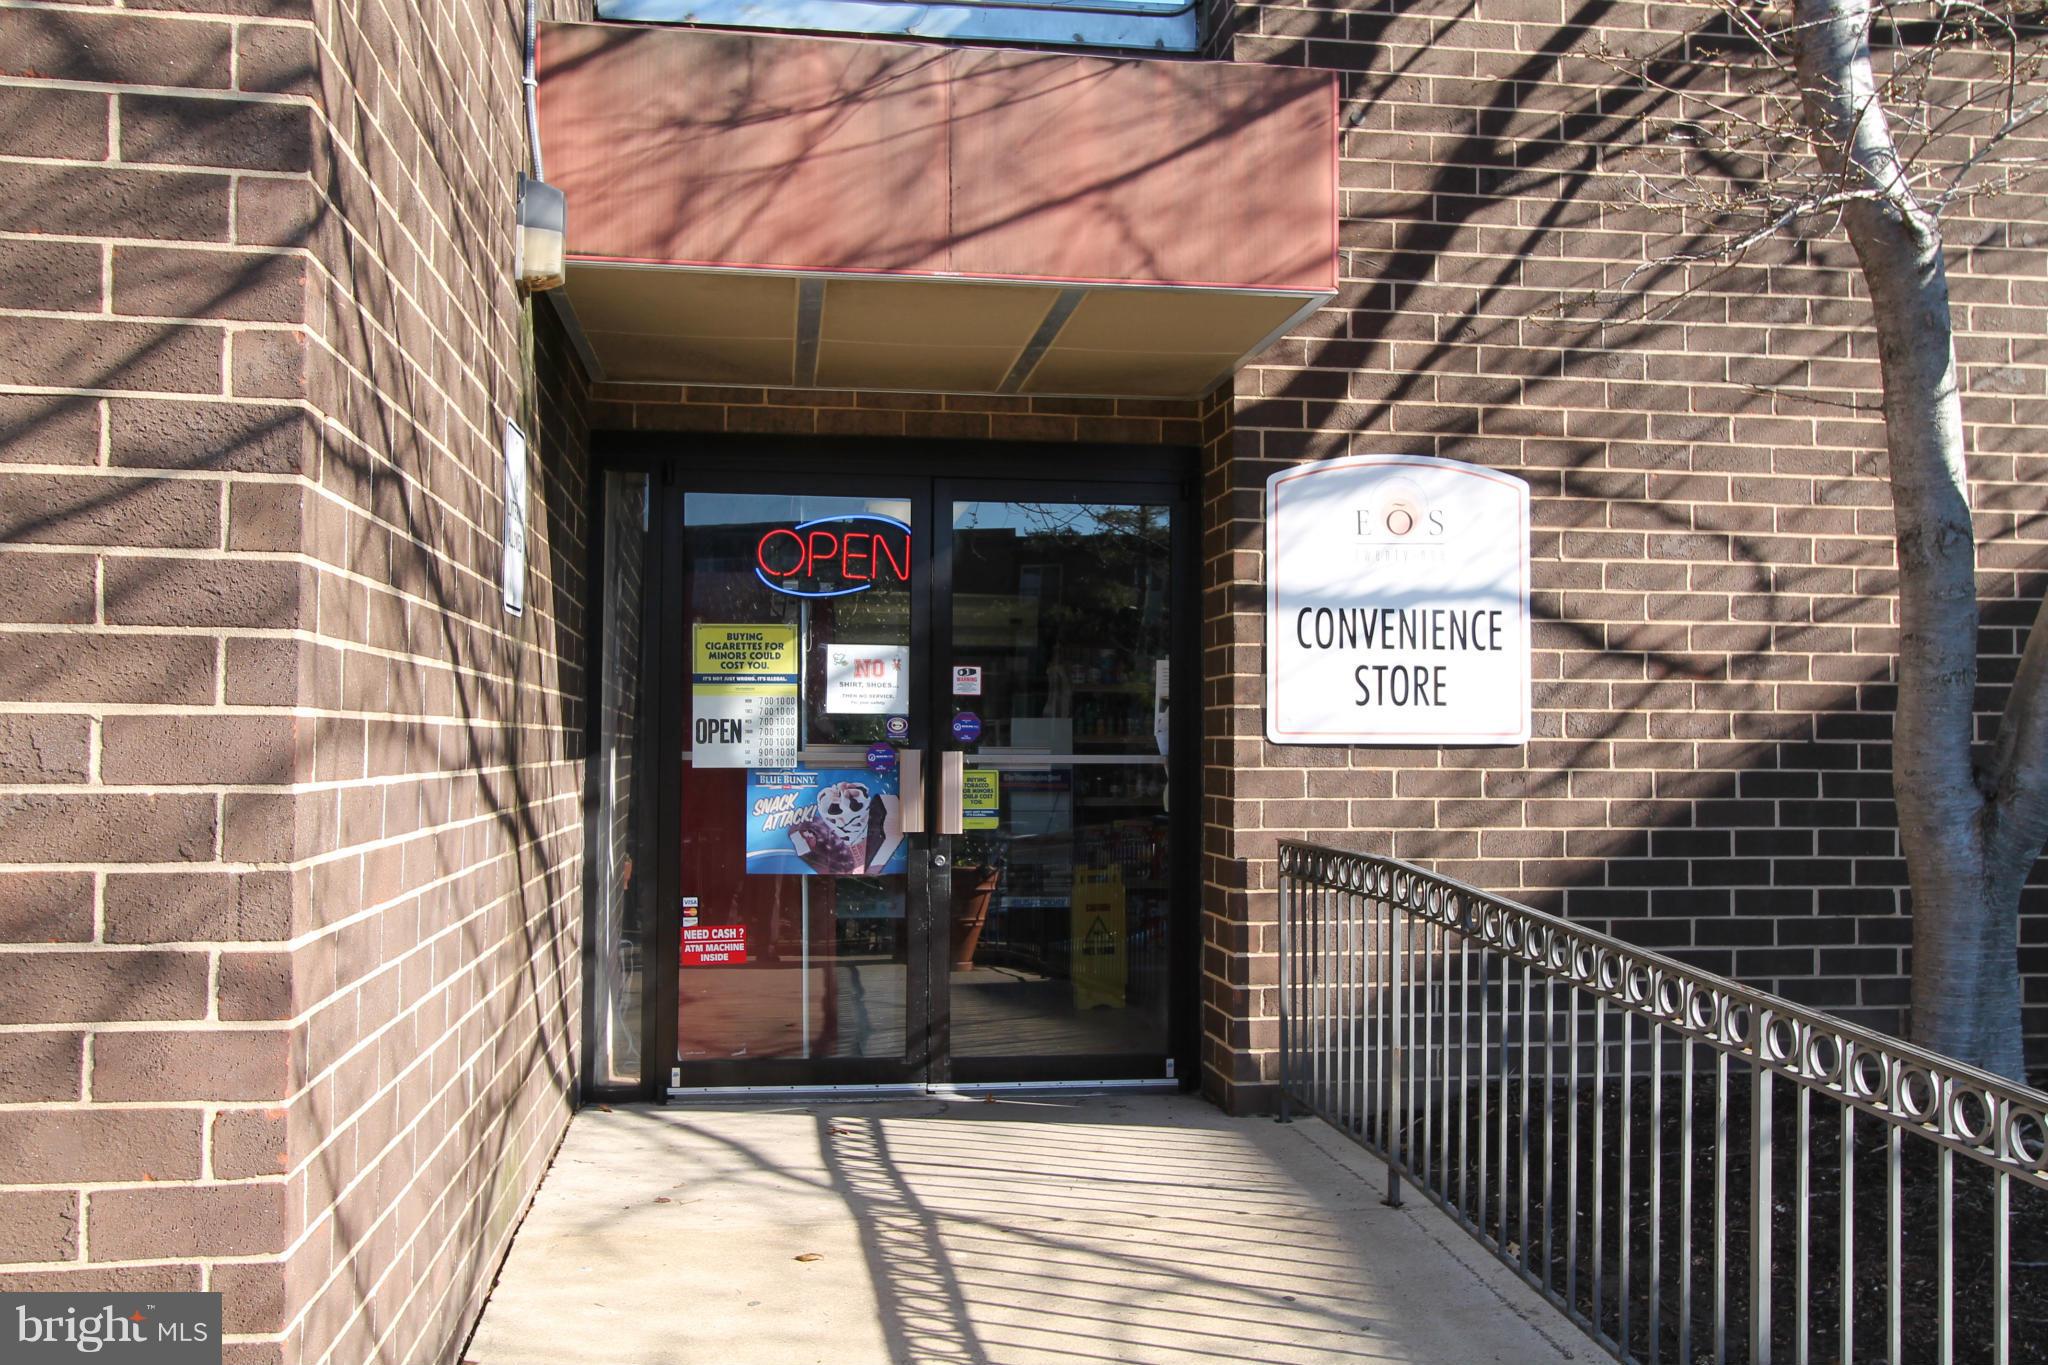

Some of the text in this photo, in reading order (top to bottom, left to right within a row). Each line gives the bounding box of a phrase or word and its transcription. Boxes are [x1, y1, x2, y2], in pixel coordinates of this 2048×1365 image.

[757, 529, 911, 581] OPEN
[1296, 606, 1503, 651] CONVENIENCE
[726, 632, 763, 641] BUYING
[704, 642, 784, 651] CIGARETTES FOR
[708, 651, 781, 660] MINORS COULD
[720, 661, 770, 670] COST YOU.
[853, 658, 885, 679] NO
[1355, 664, 1447, 706] STORE
[695, 718, 742, 744] OPEN
[760, 776, 782, 784] BLUE
[752, 792, 798, 816] SNACK
[762, 805, 815, 831] ATTACK!
[684, 930, 710, 940] NEED
[711, 928, 737, 939] CASH
[684, 943, 744, 952] ATM MACHINE
[700, 953, 729, 962] INSIDE
